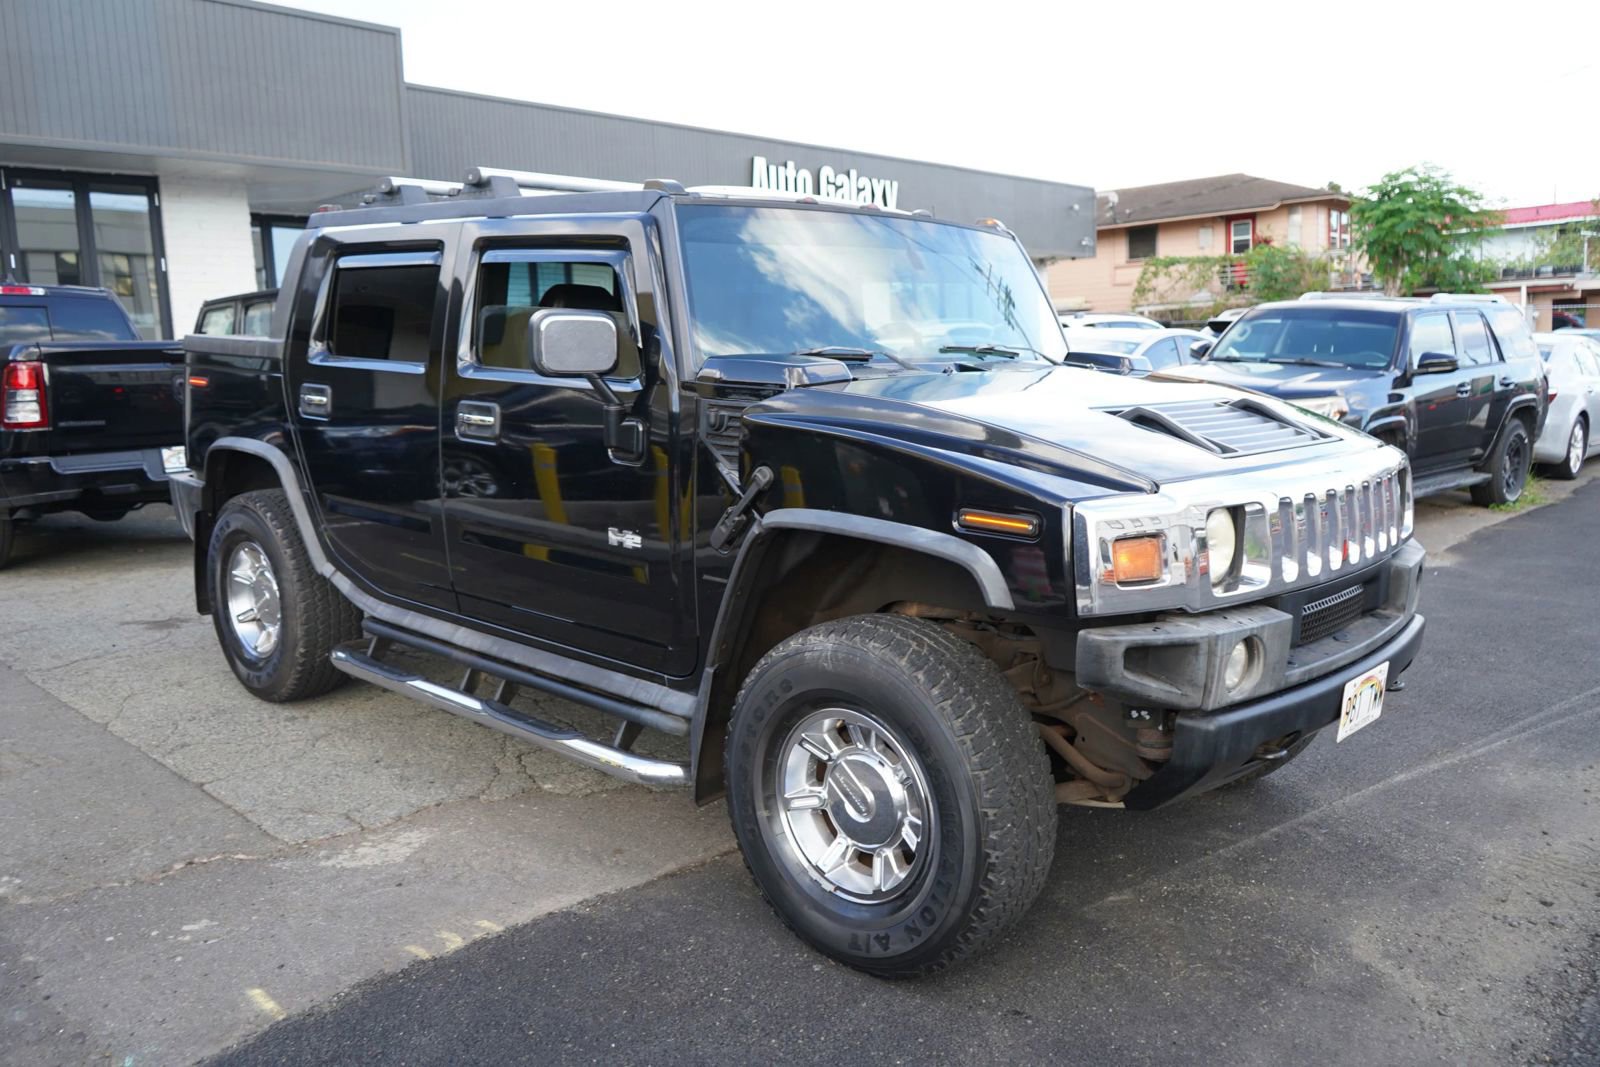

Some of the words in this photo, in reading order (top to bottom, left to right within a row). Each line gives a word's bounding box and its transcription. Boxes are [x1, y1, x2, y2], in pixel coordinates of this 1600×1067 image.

[752, 155, 813, 196] Auto
[819, 165, 899, 210] Galaxy
[607, 526, 643, 549] H2
